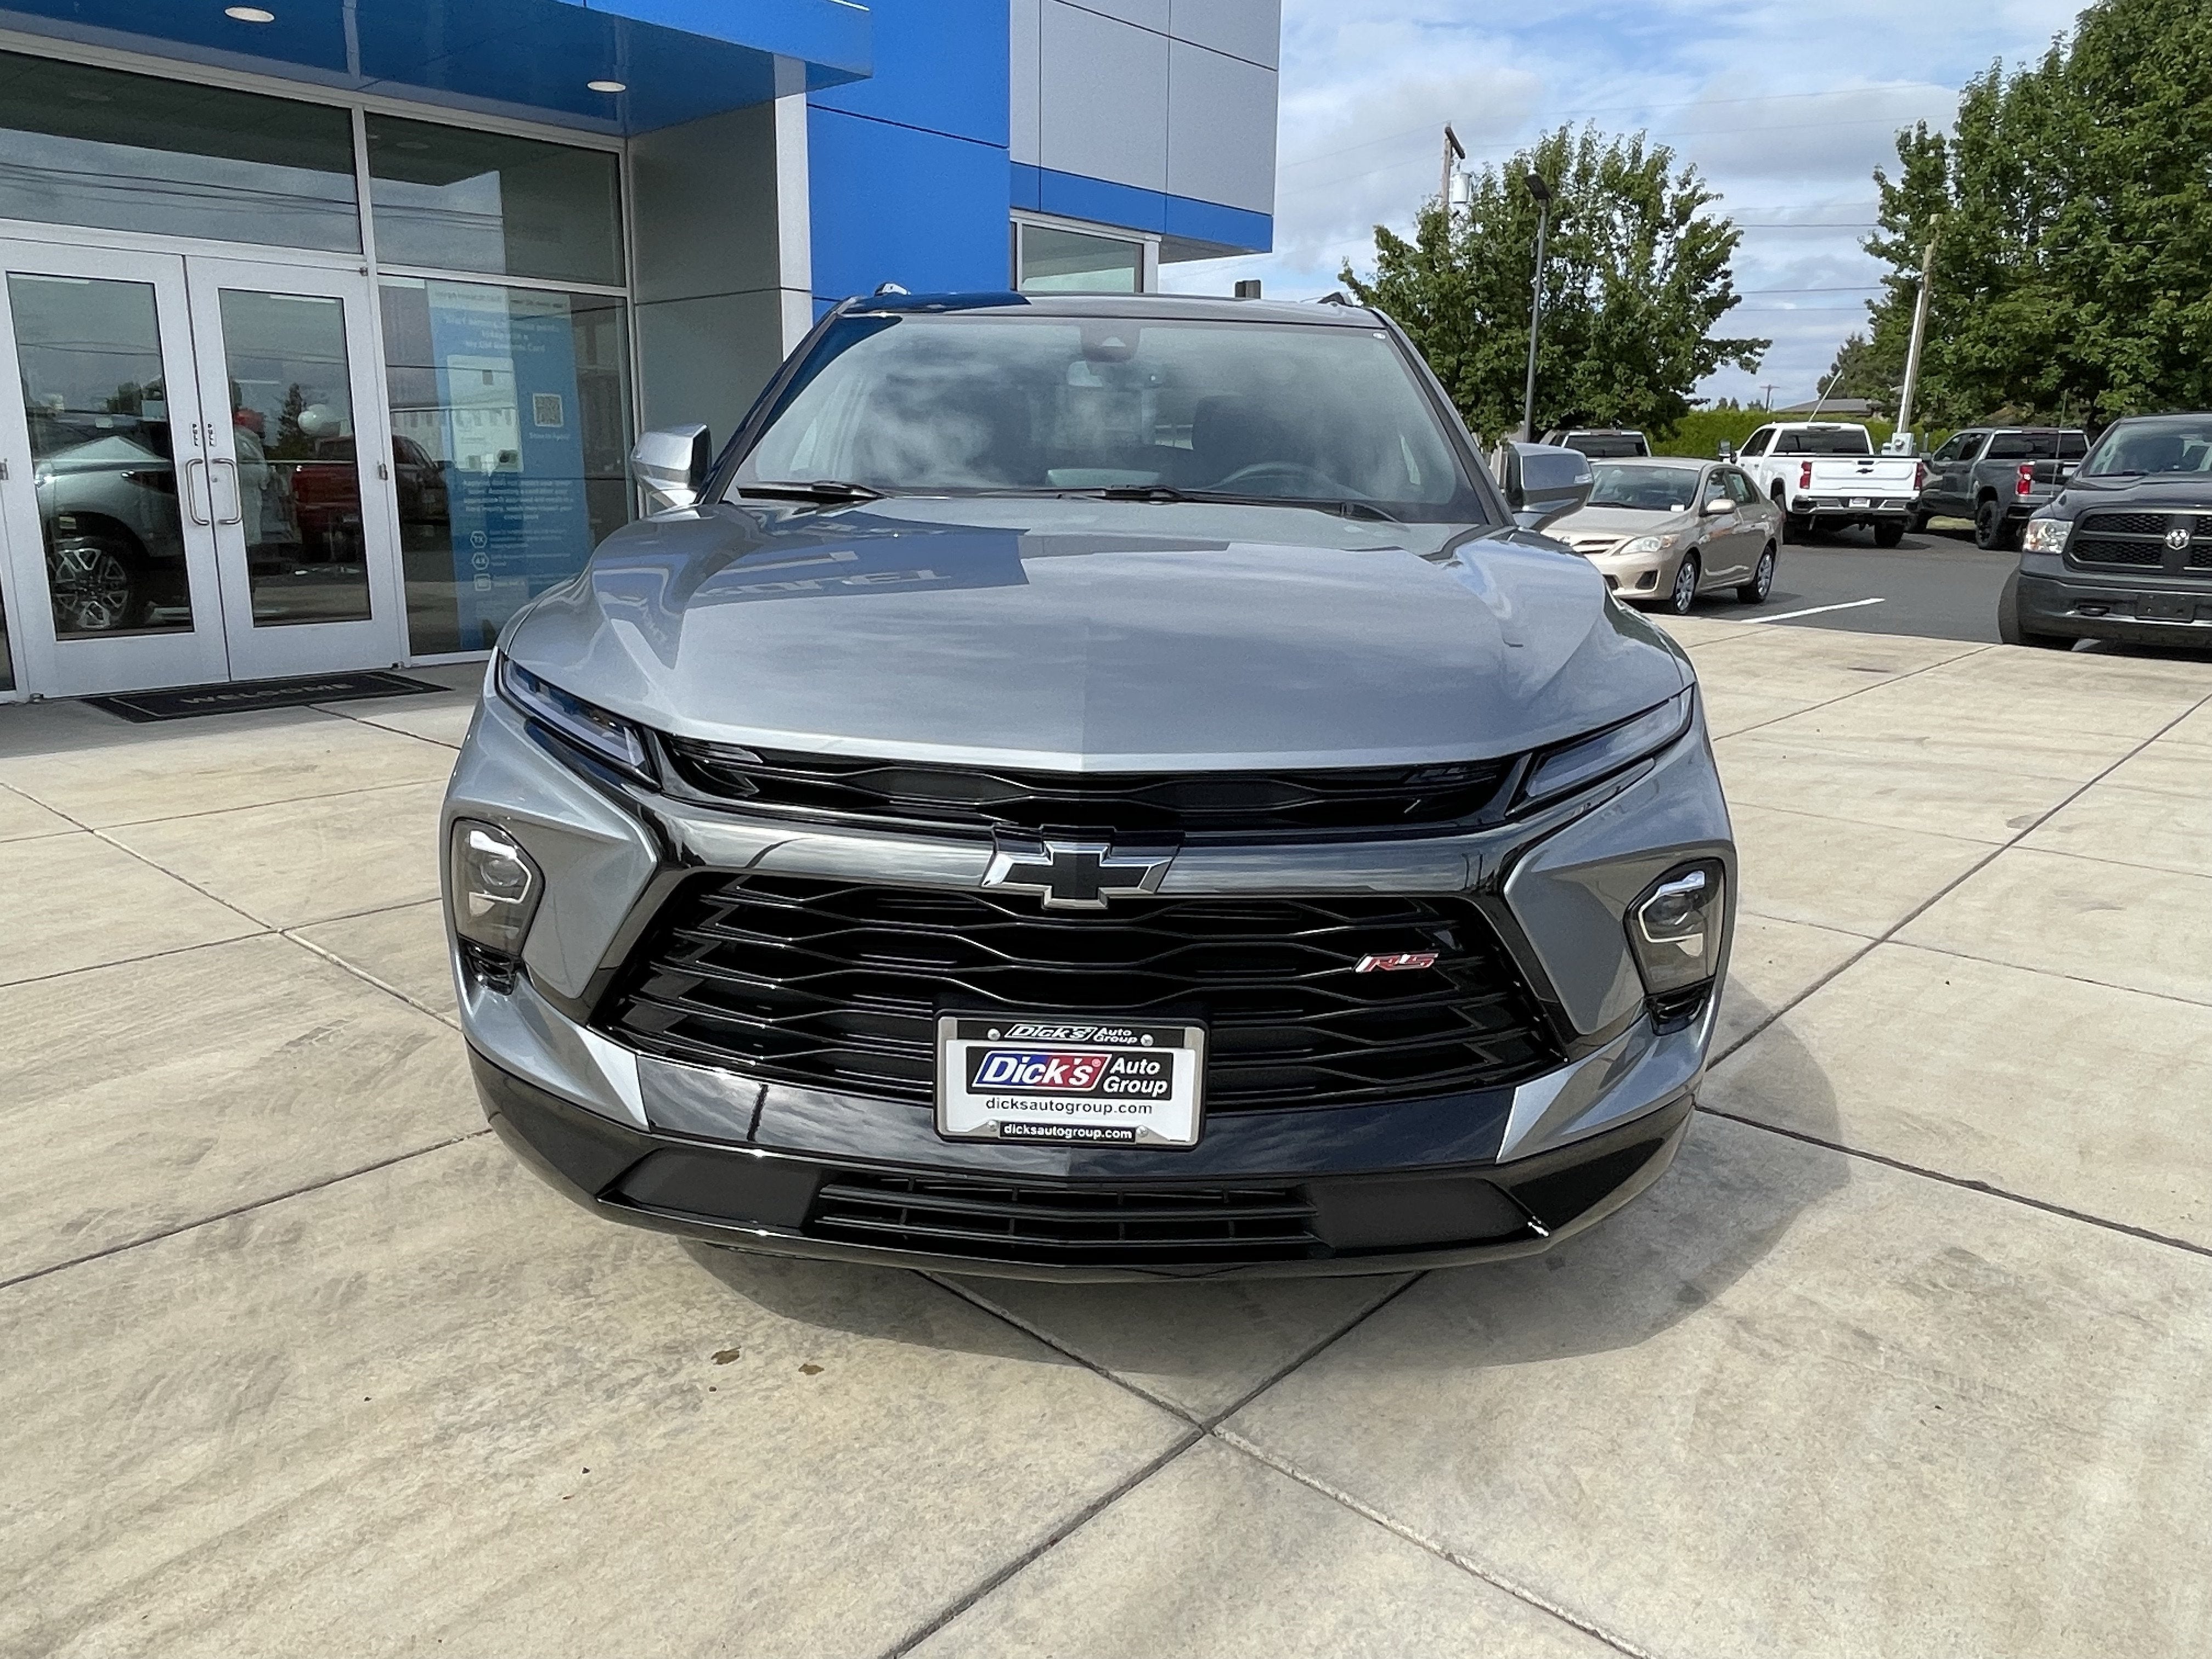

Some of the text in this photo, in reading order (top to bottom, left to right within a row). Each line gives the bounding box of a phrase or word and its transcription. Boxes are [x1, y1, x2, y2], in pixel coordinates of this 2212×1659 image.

[1353, 953, 1438, 973] RS
[1093, 1035, 1138, 1044] Group
[1097, 1027, 1132, 1036] Auto
[982, 1056, 1094, 1086] Dick's
[1109, 1057, 1161, 1075] Auto
[1103, 1075, 1168, 1097] Group
[985, 1097, 1153, 1116] dicksautogroup.com
[1003, 1124, 1133, 1139] dicksautogroup.com
